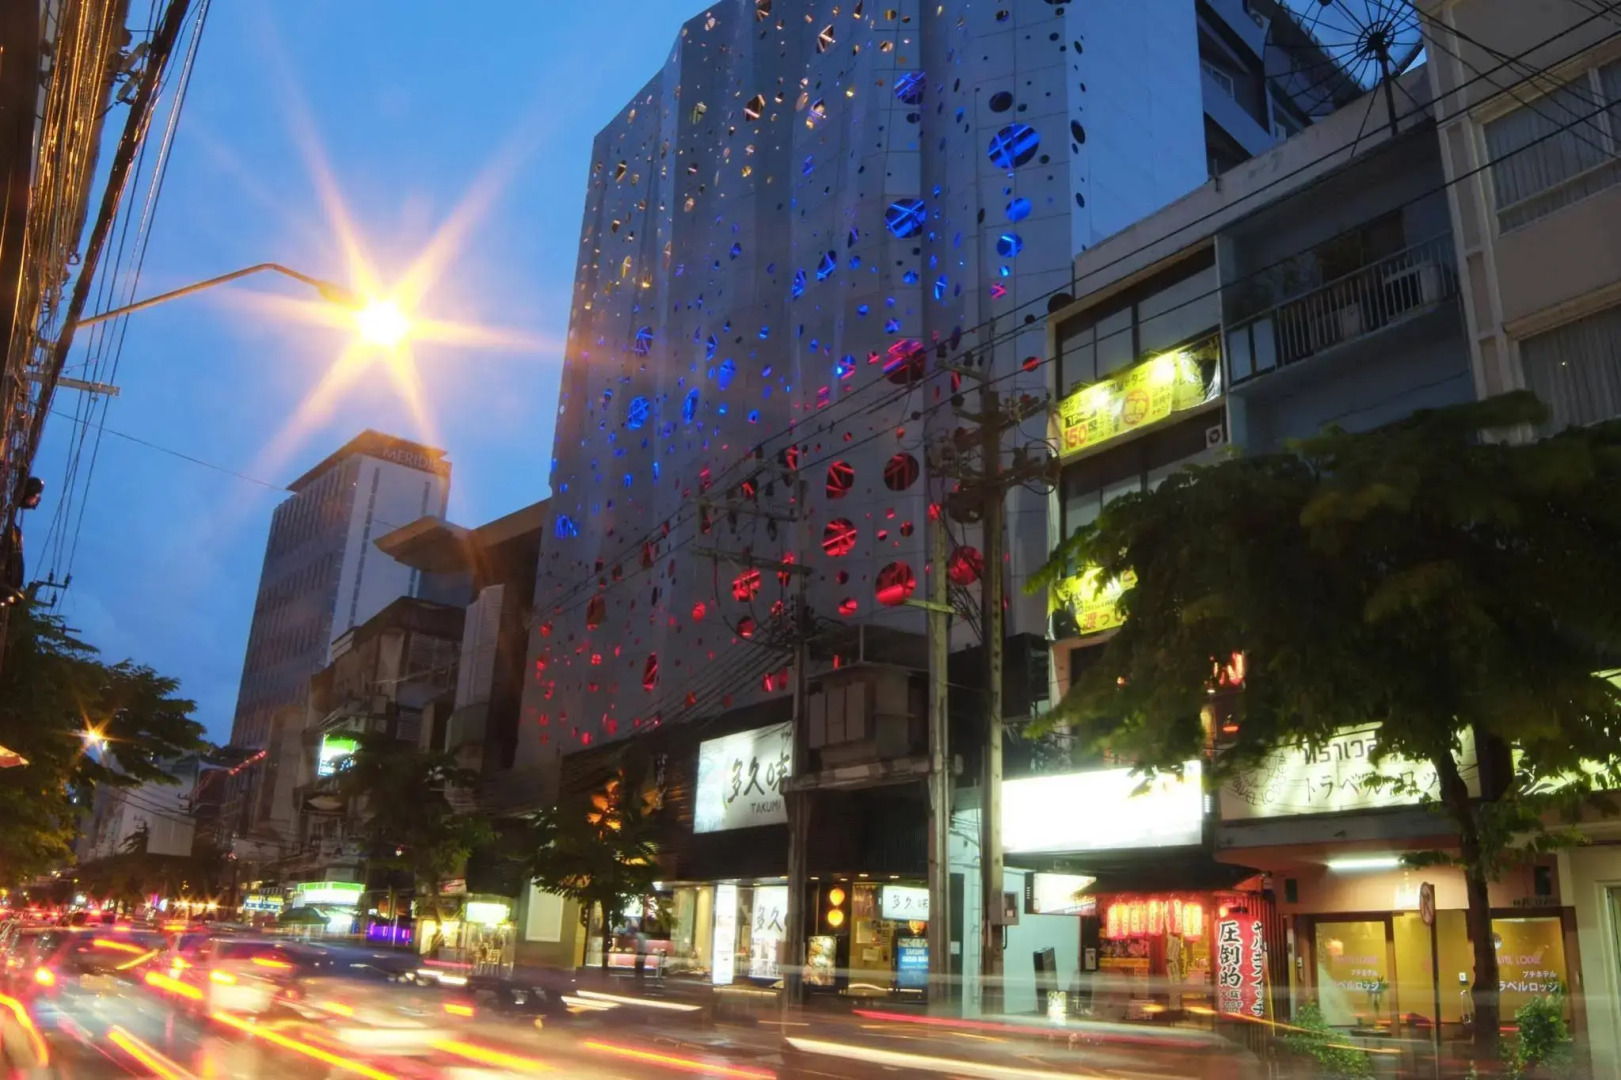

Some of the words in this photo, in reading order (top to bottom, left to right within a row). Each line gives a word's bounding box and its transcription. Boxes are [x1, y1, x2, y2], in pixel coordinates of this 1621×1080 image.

[727, 752, 790, 803] 多久味
[1219, 921, 1243, 987] 圧倒的
